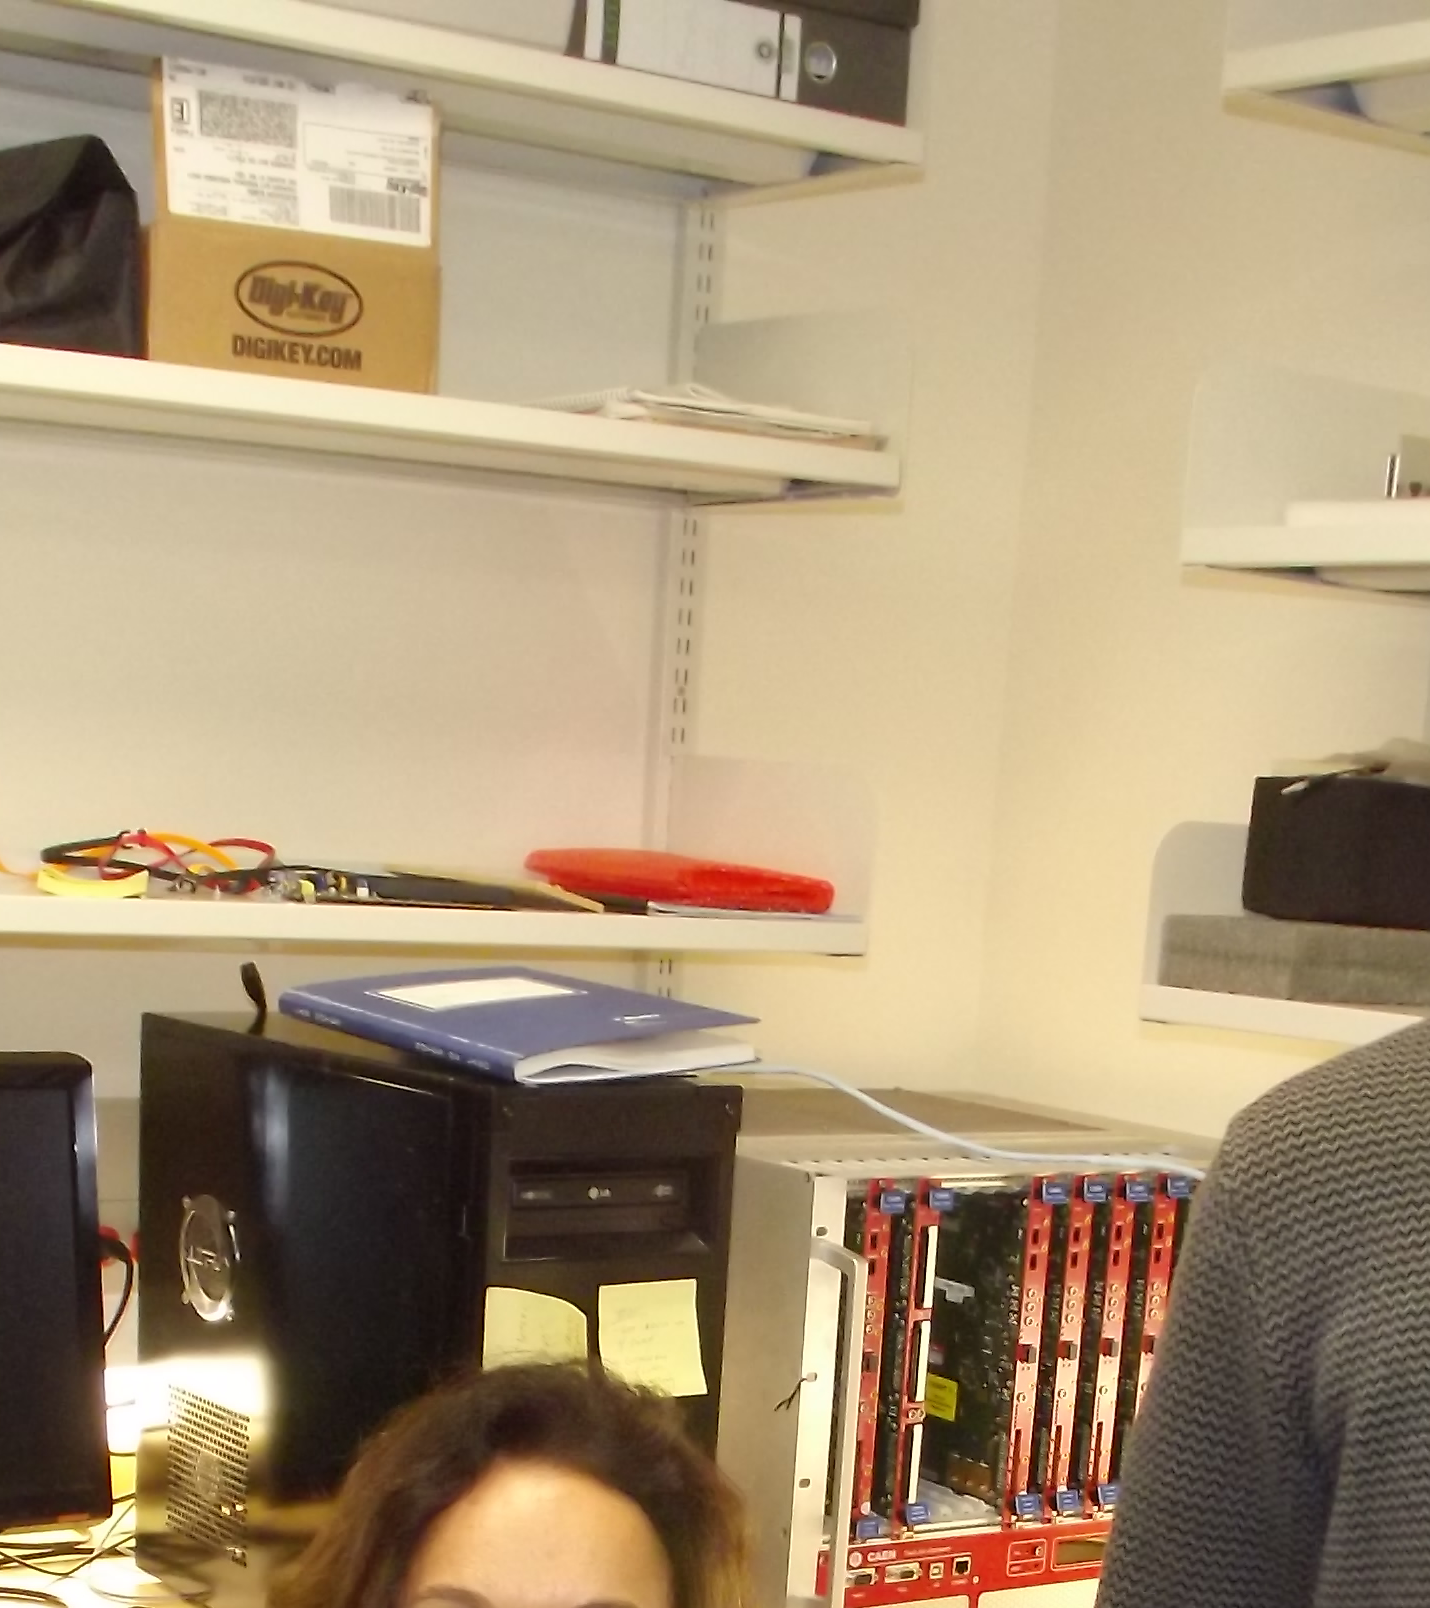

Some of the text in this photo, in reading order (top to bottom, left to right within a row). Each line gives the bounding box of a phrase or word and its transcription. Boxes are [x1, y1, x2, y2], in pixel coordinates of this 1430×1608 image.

[248, 275, 350, 324] Digi-Key
[232, 334, 362, 371] DIGIKEY.COM
[867, 1550, 897, 1562] CAEN
